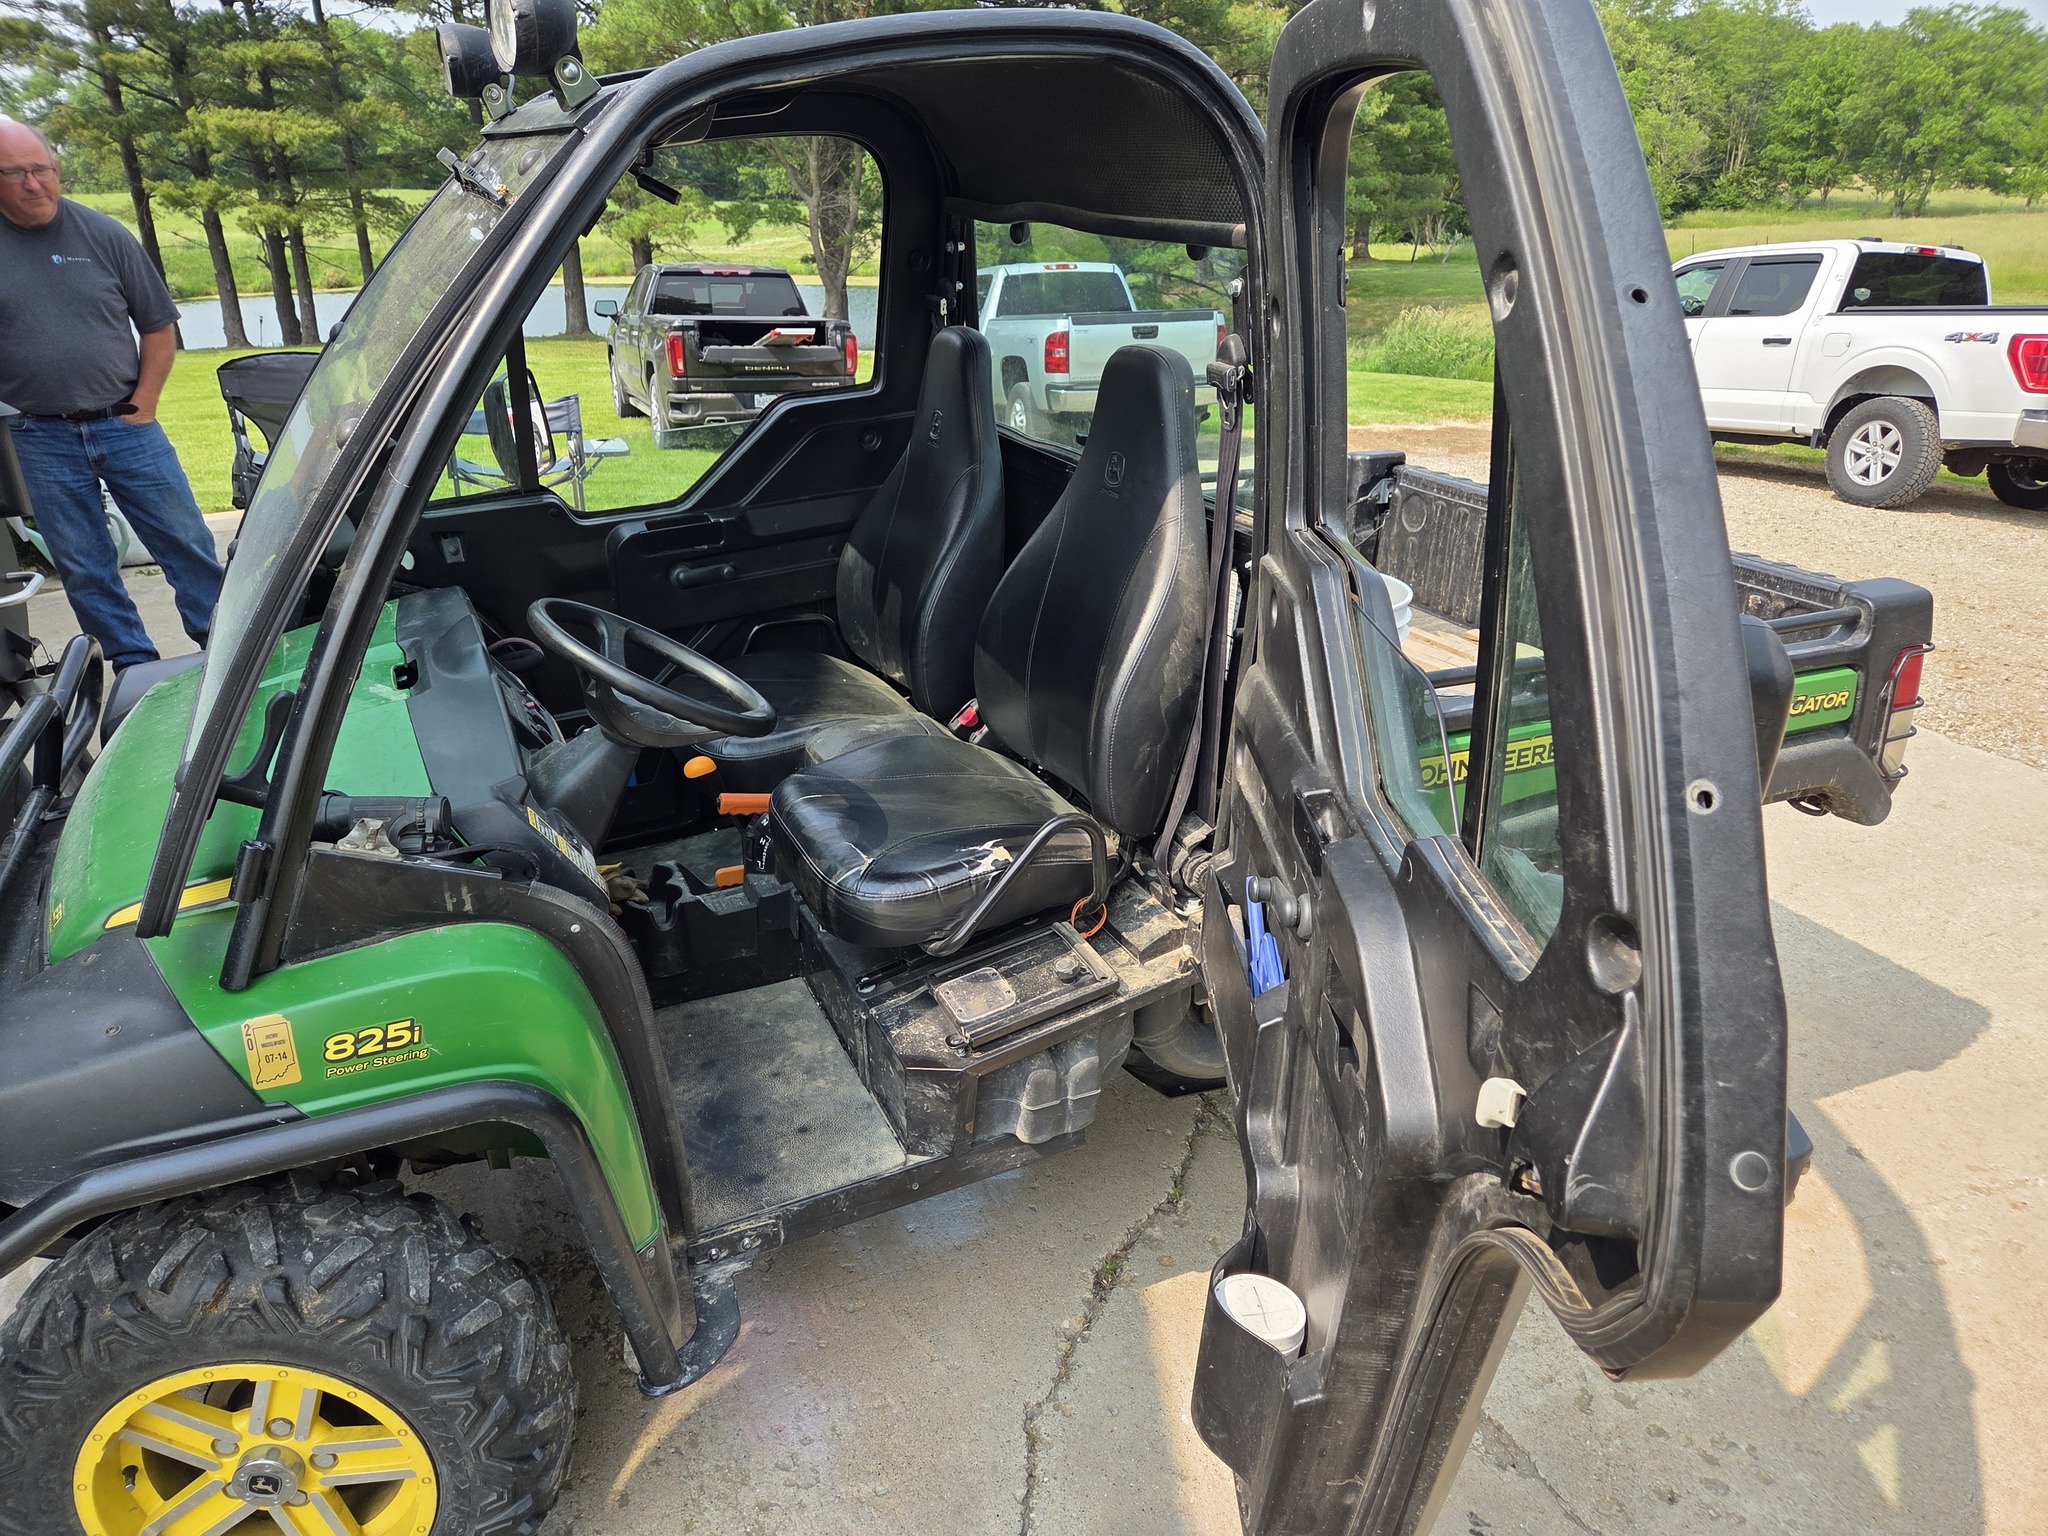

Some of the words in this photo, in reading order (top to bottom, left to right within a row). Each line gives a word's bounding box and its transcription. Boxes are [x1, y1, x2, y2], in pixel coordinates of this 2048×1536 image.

[1789, 690, 1850, 715] GATOR
[1420, 759, 1470, 784] OHN
[323, 1017, 423, 1063] 825i
[264, 1051, 288, 1064] 07-14
[326, 1060, 370, 1079] Power
[372, 1047, 429, 1068] Steering
